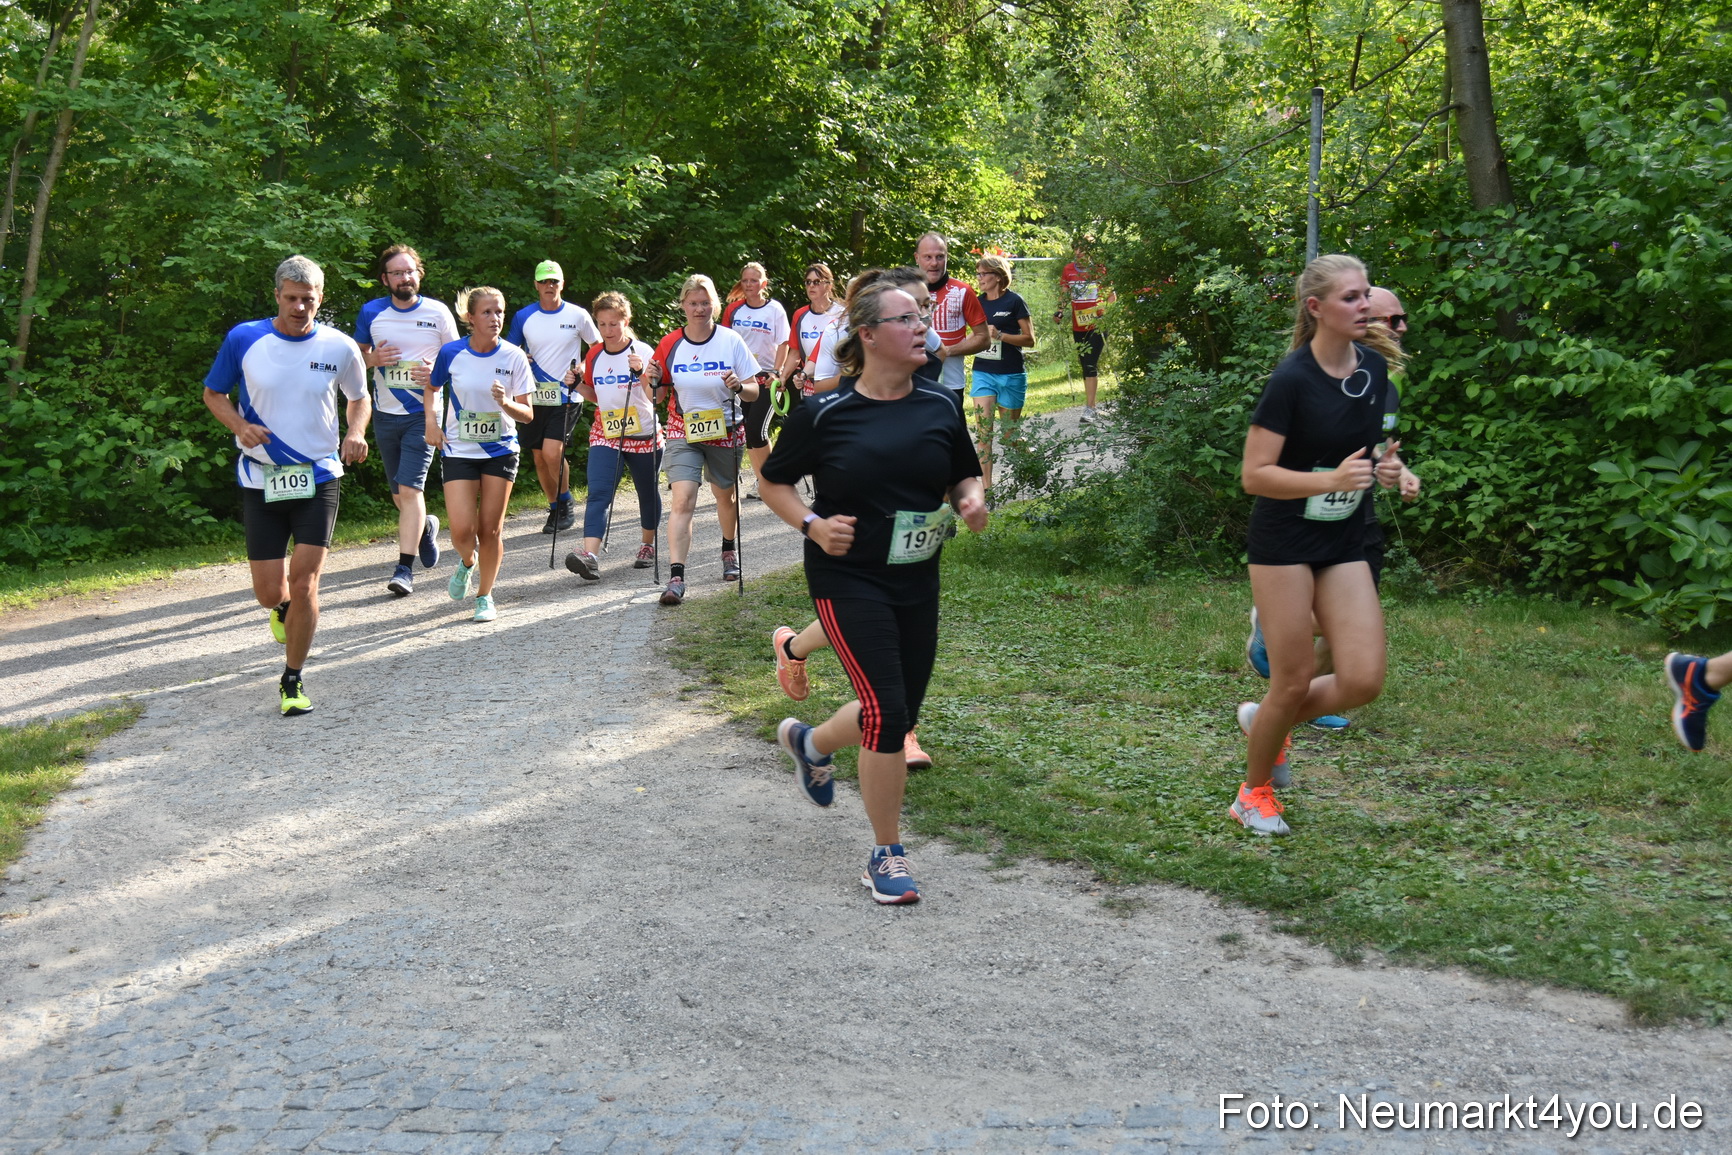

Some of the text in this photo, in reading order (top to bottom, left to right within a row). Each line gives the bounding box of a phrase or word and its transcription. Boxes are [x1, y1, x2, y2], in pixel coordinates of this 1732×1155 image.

[534, 390, 557, 399] 1108
[464, 421, 496, 434] 1104
[606, 416, 635, 431] 2064
[689, 419, 720, 434] 2071
[270, 474, 308, 490] 1109
[1324, 489, 1358, 506] 442
[903, 523, 945, 549] 1979
